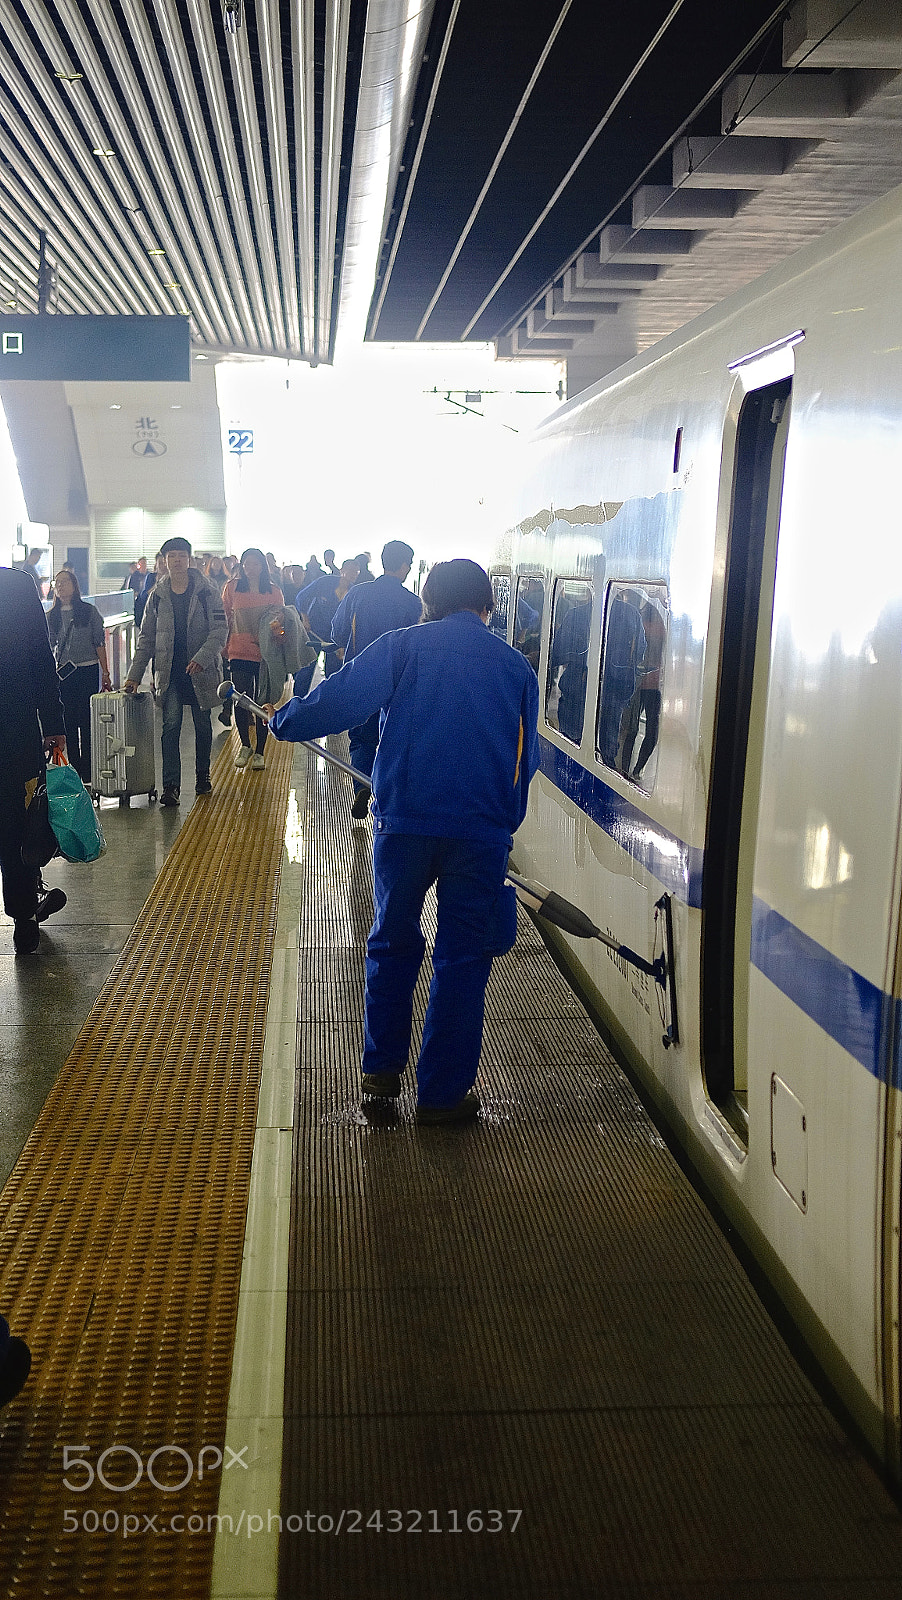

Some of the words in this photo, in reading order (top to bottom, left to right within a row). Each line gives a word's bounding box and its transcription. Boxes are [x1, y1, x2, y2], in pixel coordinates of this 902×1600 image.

[3, 332, 24, 354] 口
[135, 416, 159, 430] 北
[228, 431, 254, 452] 22
